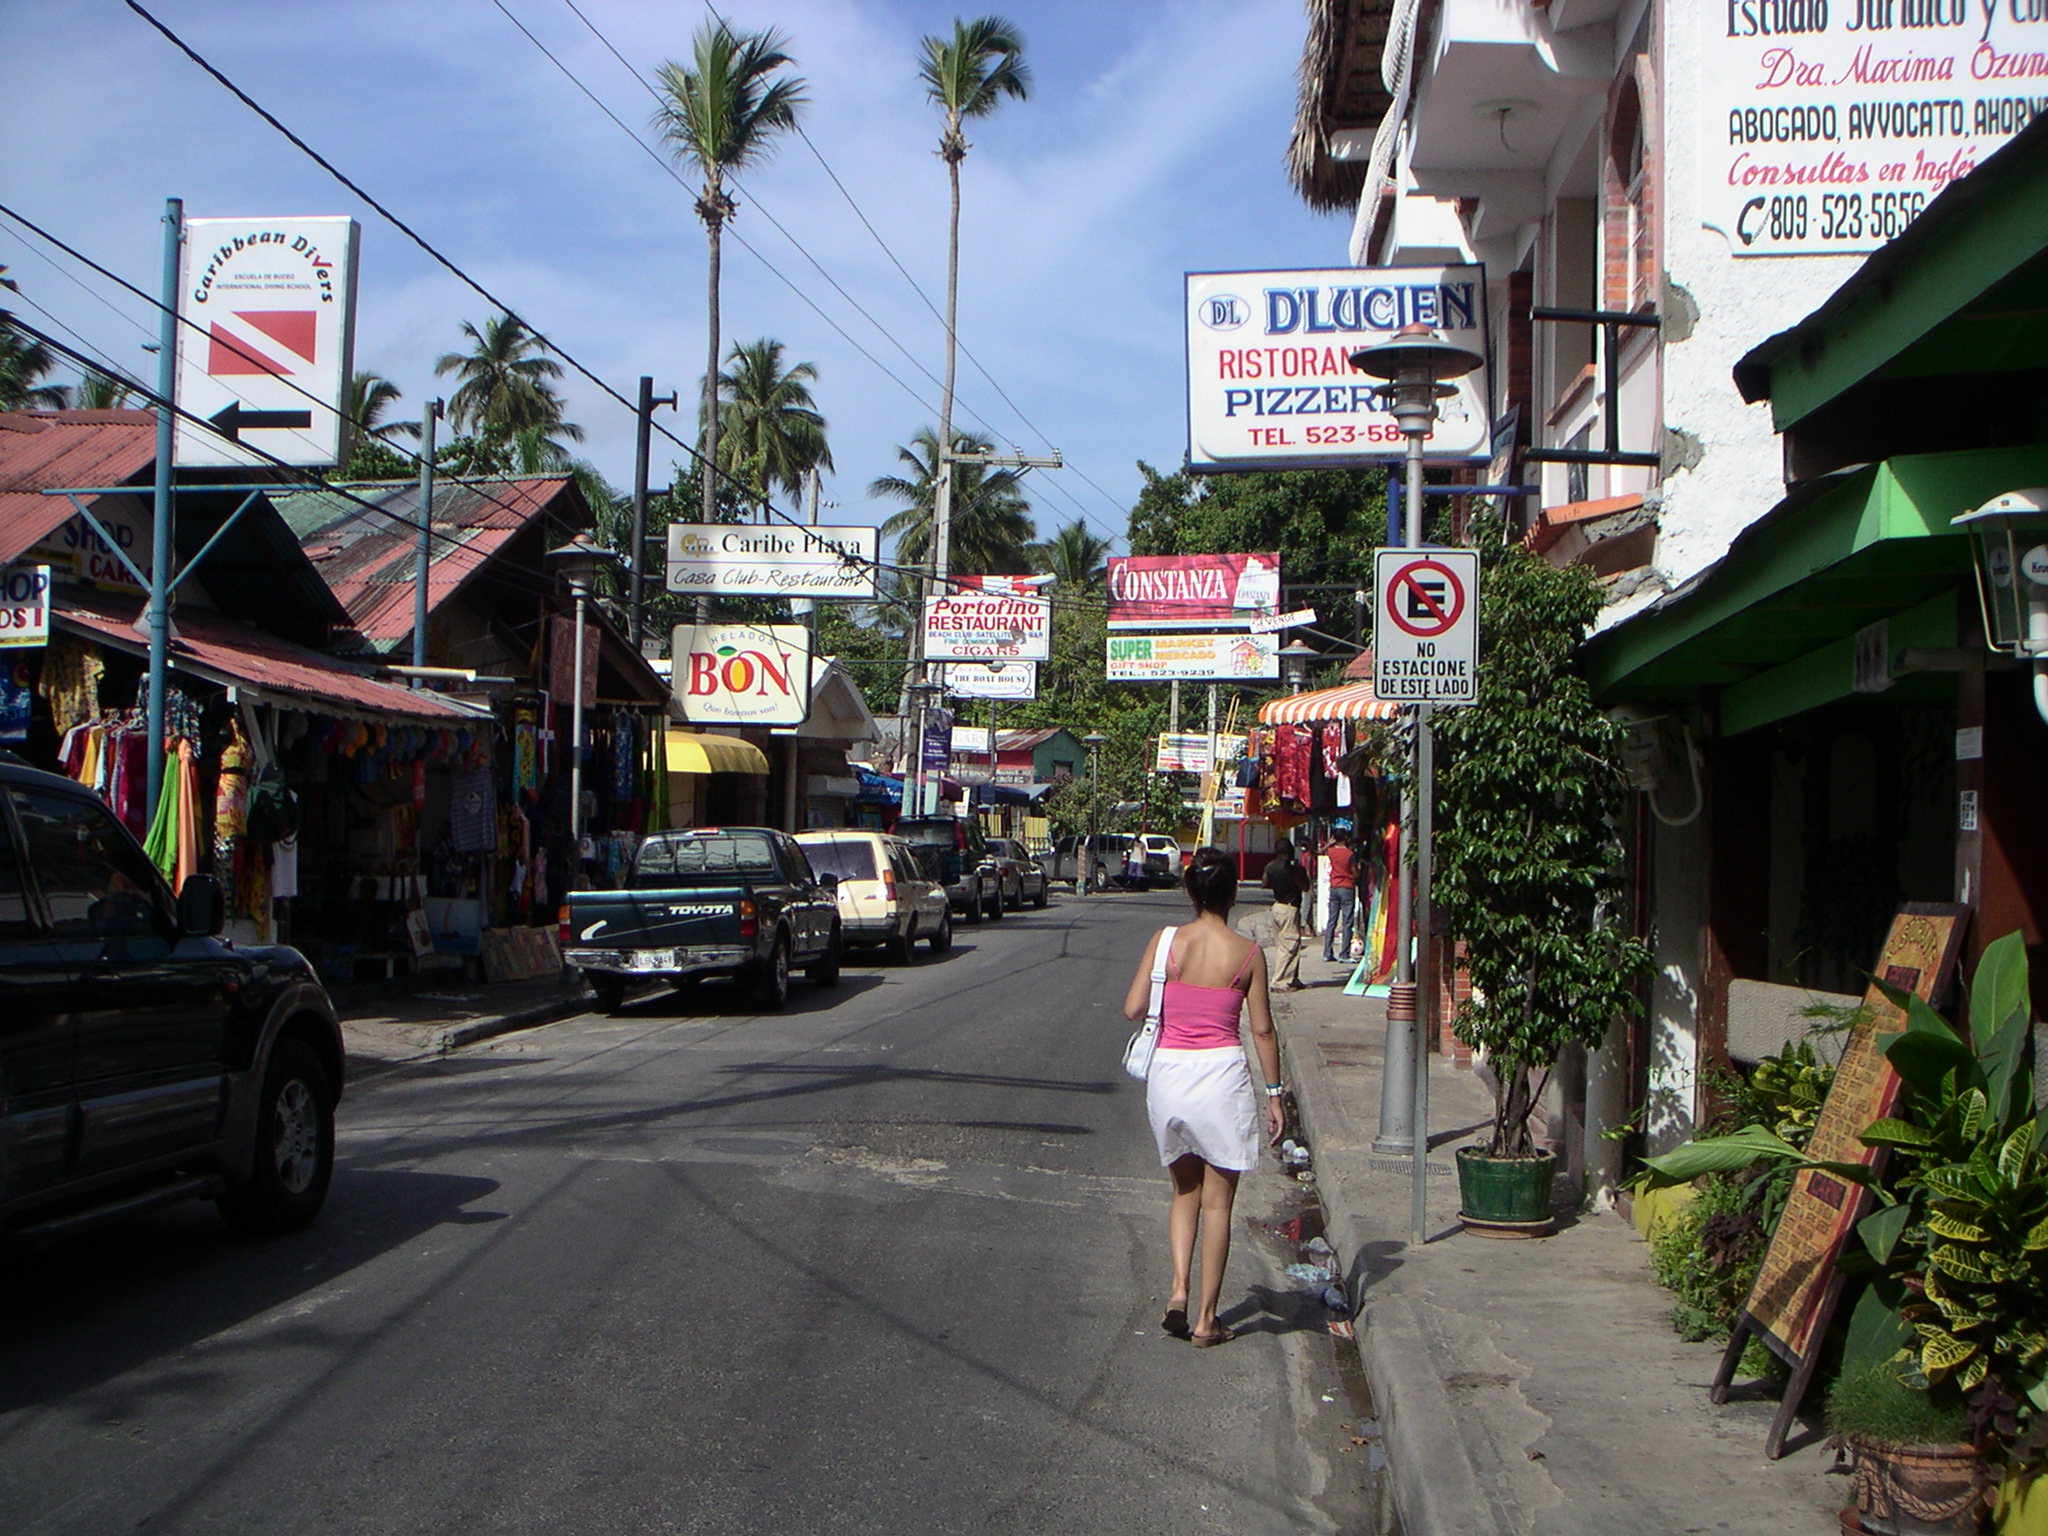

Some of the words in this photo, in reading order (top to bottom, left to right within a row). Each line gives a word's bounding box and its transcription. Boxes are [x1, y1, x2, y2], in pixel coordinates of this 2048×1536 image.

[1979, 0, 1996, 42] y
[2008, 0, 2048, 25] Co
[1756, 47, 1828, 89] Dra.
[1832, 43, 1954, 86] Maxima
[1970, 41, 2048, 81] Ozun
[1729, 104, 1842, 145] ABOGADO,
[1850, 99, 1969, 138] AVVOCATO,
[1728, 151, 1870, 186] Consultas
[1878, 163, 1905, 182] en
[194, 231, 286, 304] Caribbean
[291, 235, 334, 303] Divers
[1219, 346, 1372, 379] RISTORAN
[1225, 386, 1390, 416] PIZZERI
[1248, 428, 1296, 446] TEL.
[1306, 425, 1435, 444] 523-58
[722, 534, 795, 554] Caribe
[803, 534, 861, 557] Playa
[674, 567, 716, 585] Casa
[934, 599, 1040, 615] Portofino
[928, 616, 1045, 630] RESTAURANT
[710, 631, 775, 646] HELADOS
[952, 646, 1020, 656] CIGARS
[1110, 639, 1152, 660] SUPER
[1155, 639, 1215, 648] MARKET
[1156, 651, 1216, 660] MERCADO
[1417, 642, 1436, 658] NO
[688, 651, 791, 696] BON
[1382, 660, 1466, 676] ESTACIONE
[973, 675, 996, 683] BOAT
[998, 675, 1026, 683] HOUSE
[1381, 679, 1397, 694] DE
[1401, 679, 1430, 694] ESTE
[1435, 680, 1469, 695] LADO
[668, 904, 734, 915] TOYOTA
